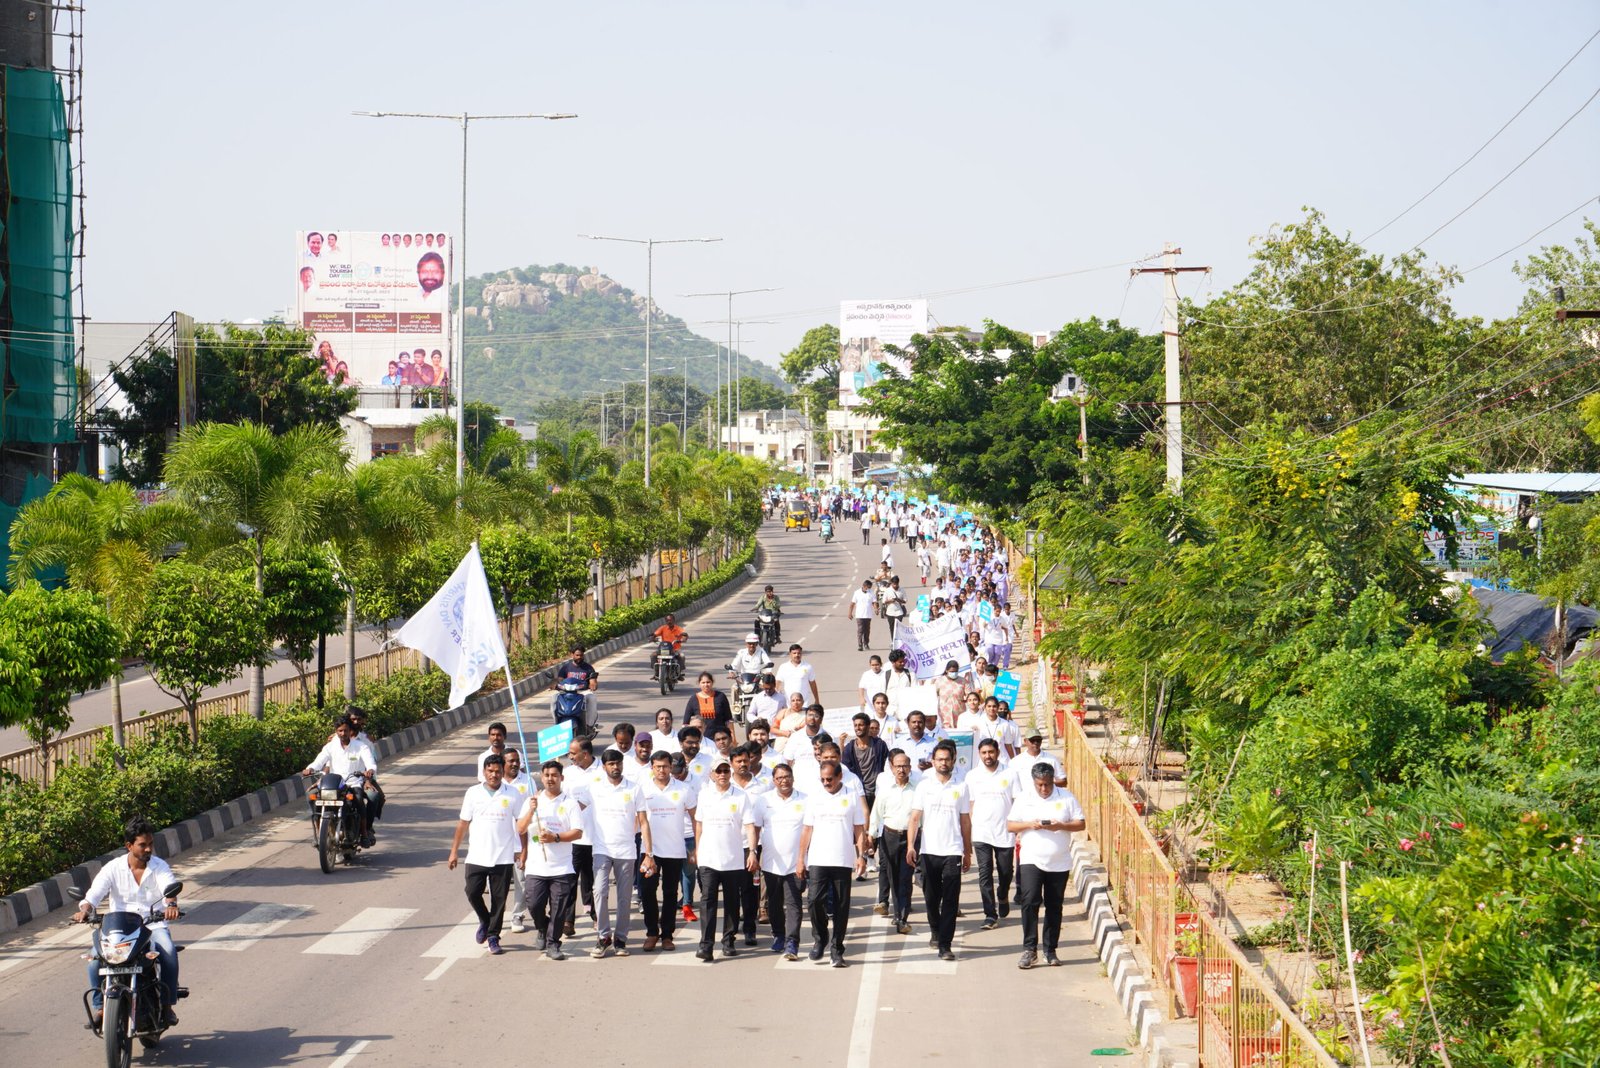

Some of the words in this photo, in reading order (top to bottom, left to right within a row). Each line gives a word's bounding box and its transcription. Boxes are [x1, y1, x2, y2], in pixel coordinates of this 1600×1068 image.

[916, 649, 940, 660] JOINT
[940, 639, 967, 652] HEALTH
[922, 658, 934, 667] FOR
[940, 652, 954, 662] ALL
